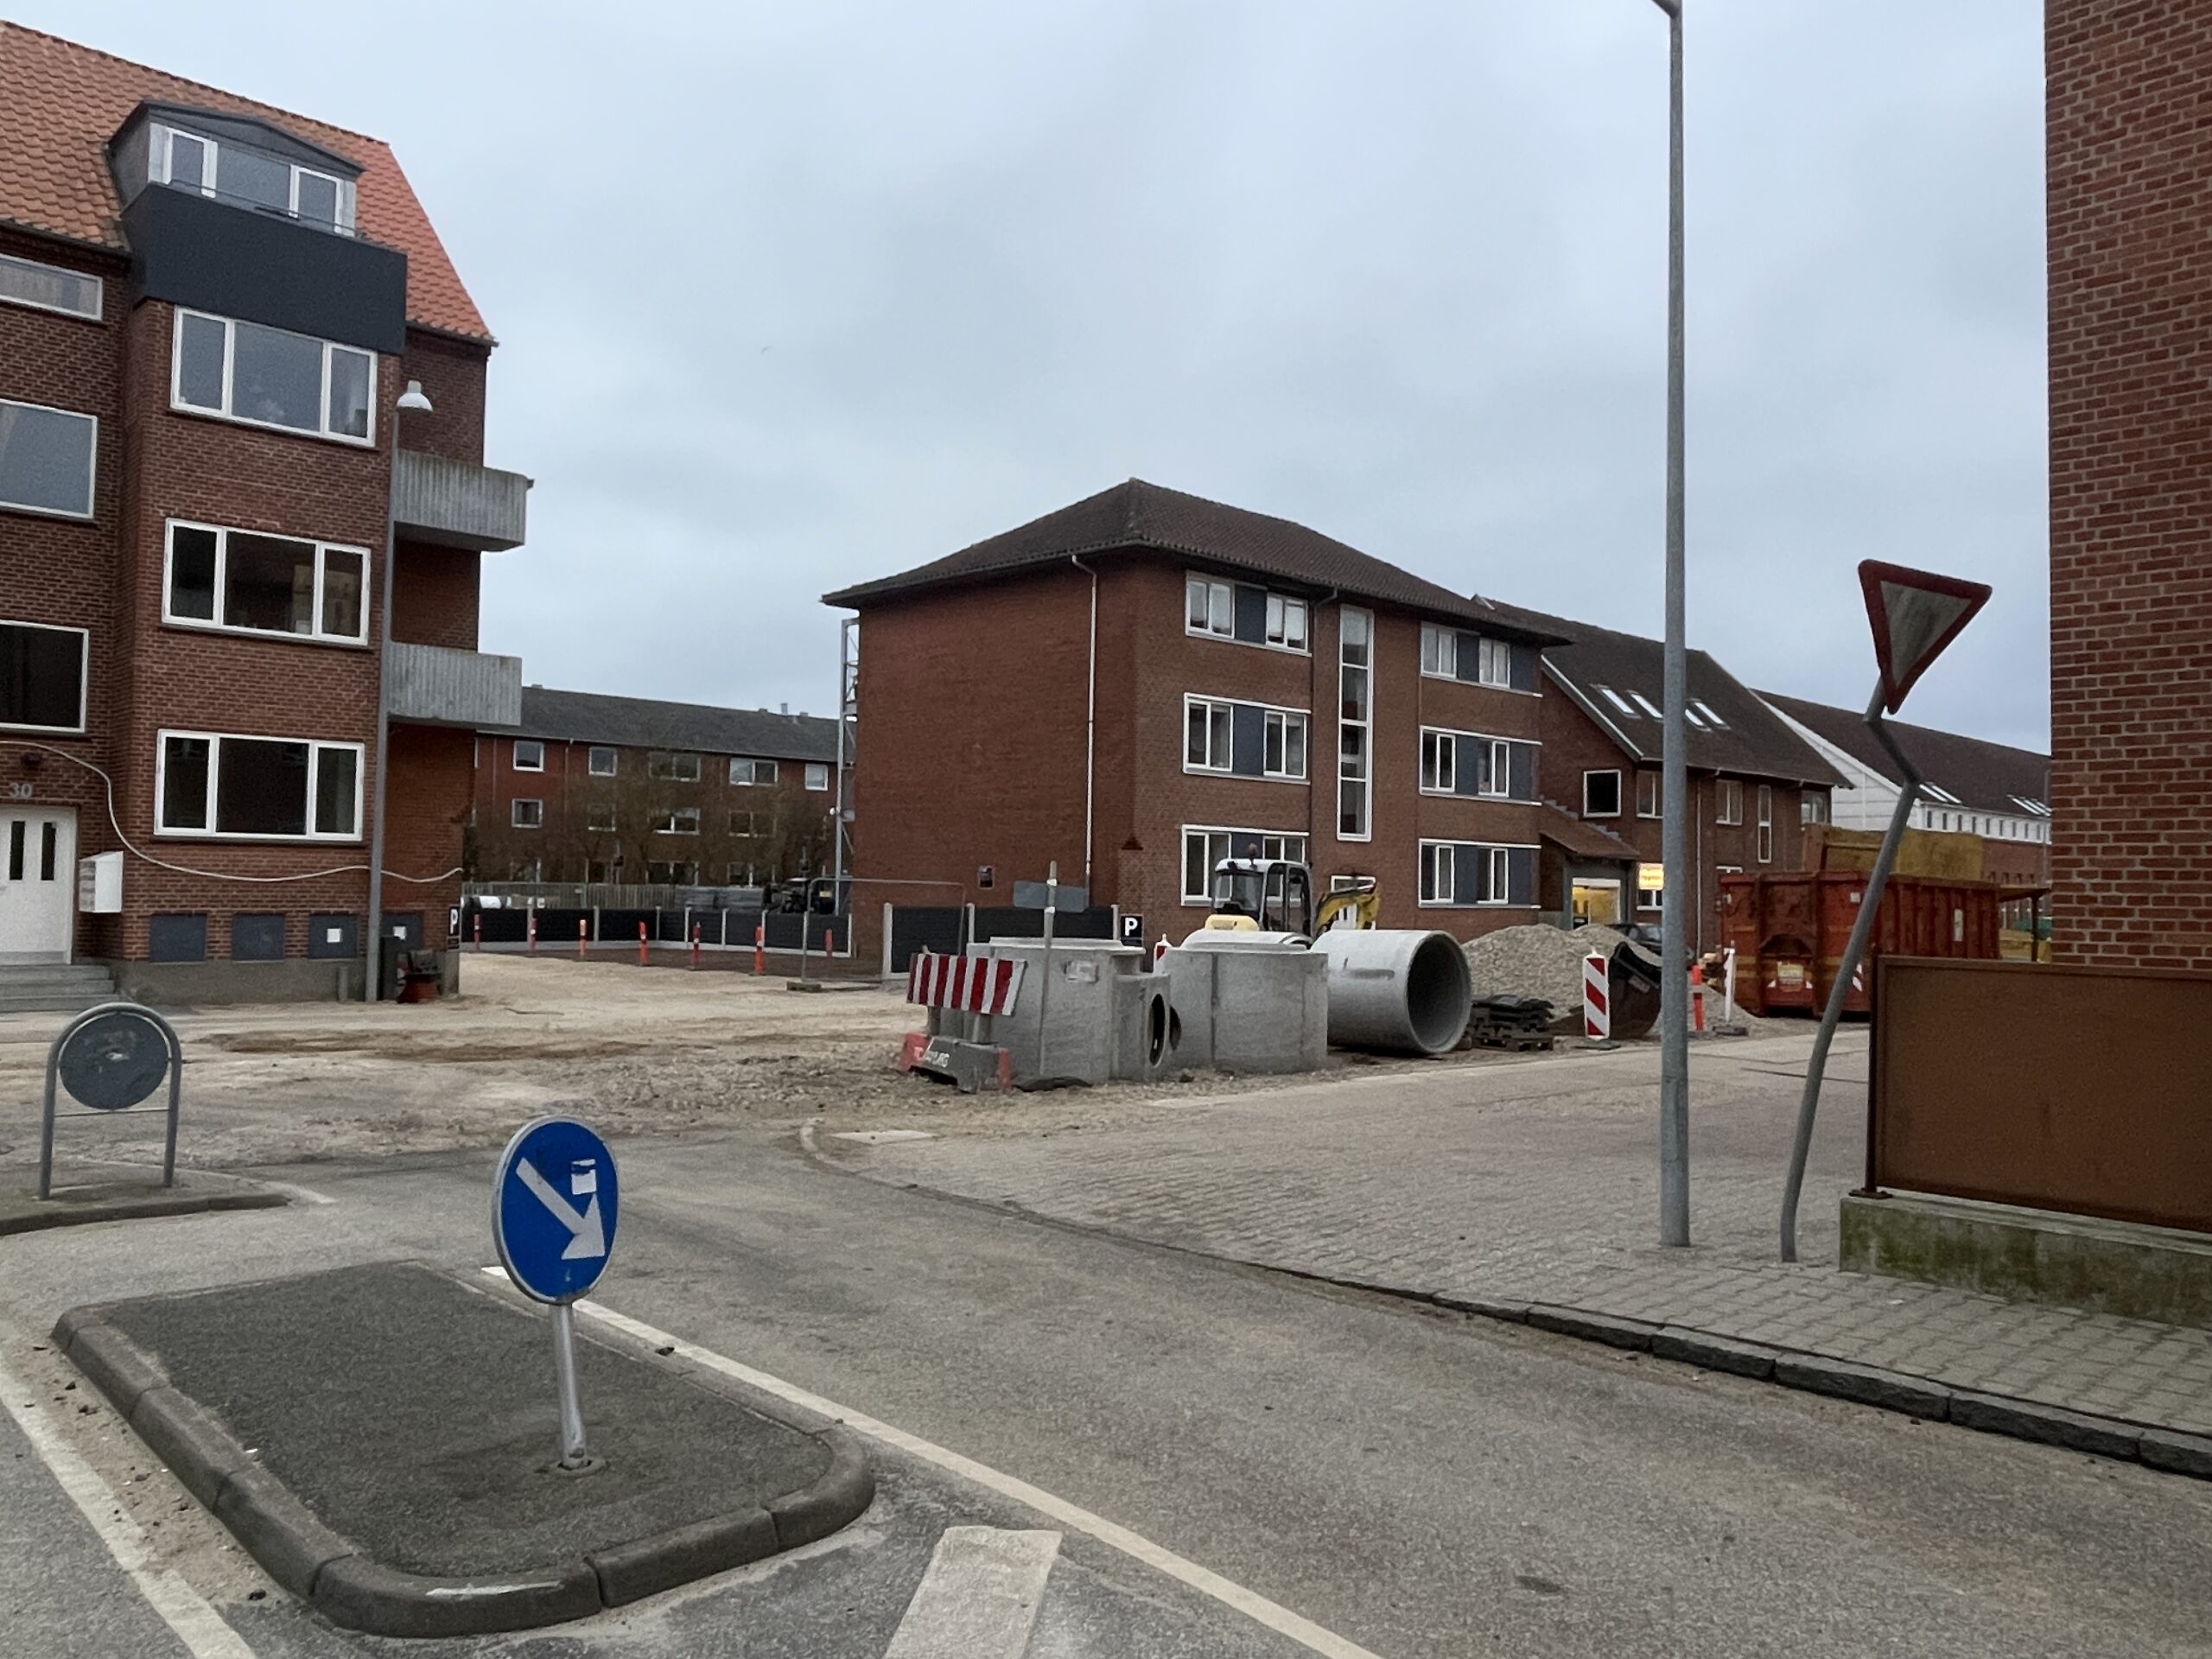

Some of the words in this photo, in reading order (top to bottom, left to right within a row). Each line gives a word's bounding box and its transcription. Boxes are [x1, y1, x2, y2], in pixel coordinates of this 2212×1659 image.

[9, 782, 33, 799] 30
[450, 908, 459, 934] P
[1125, 917, 1138, 936] P
